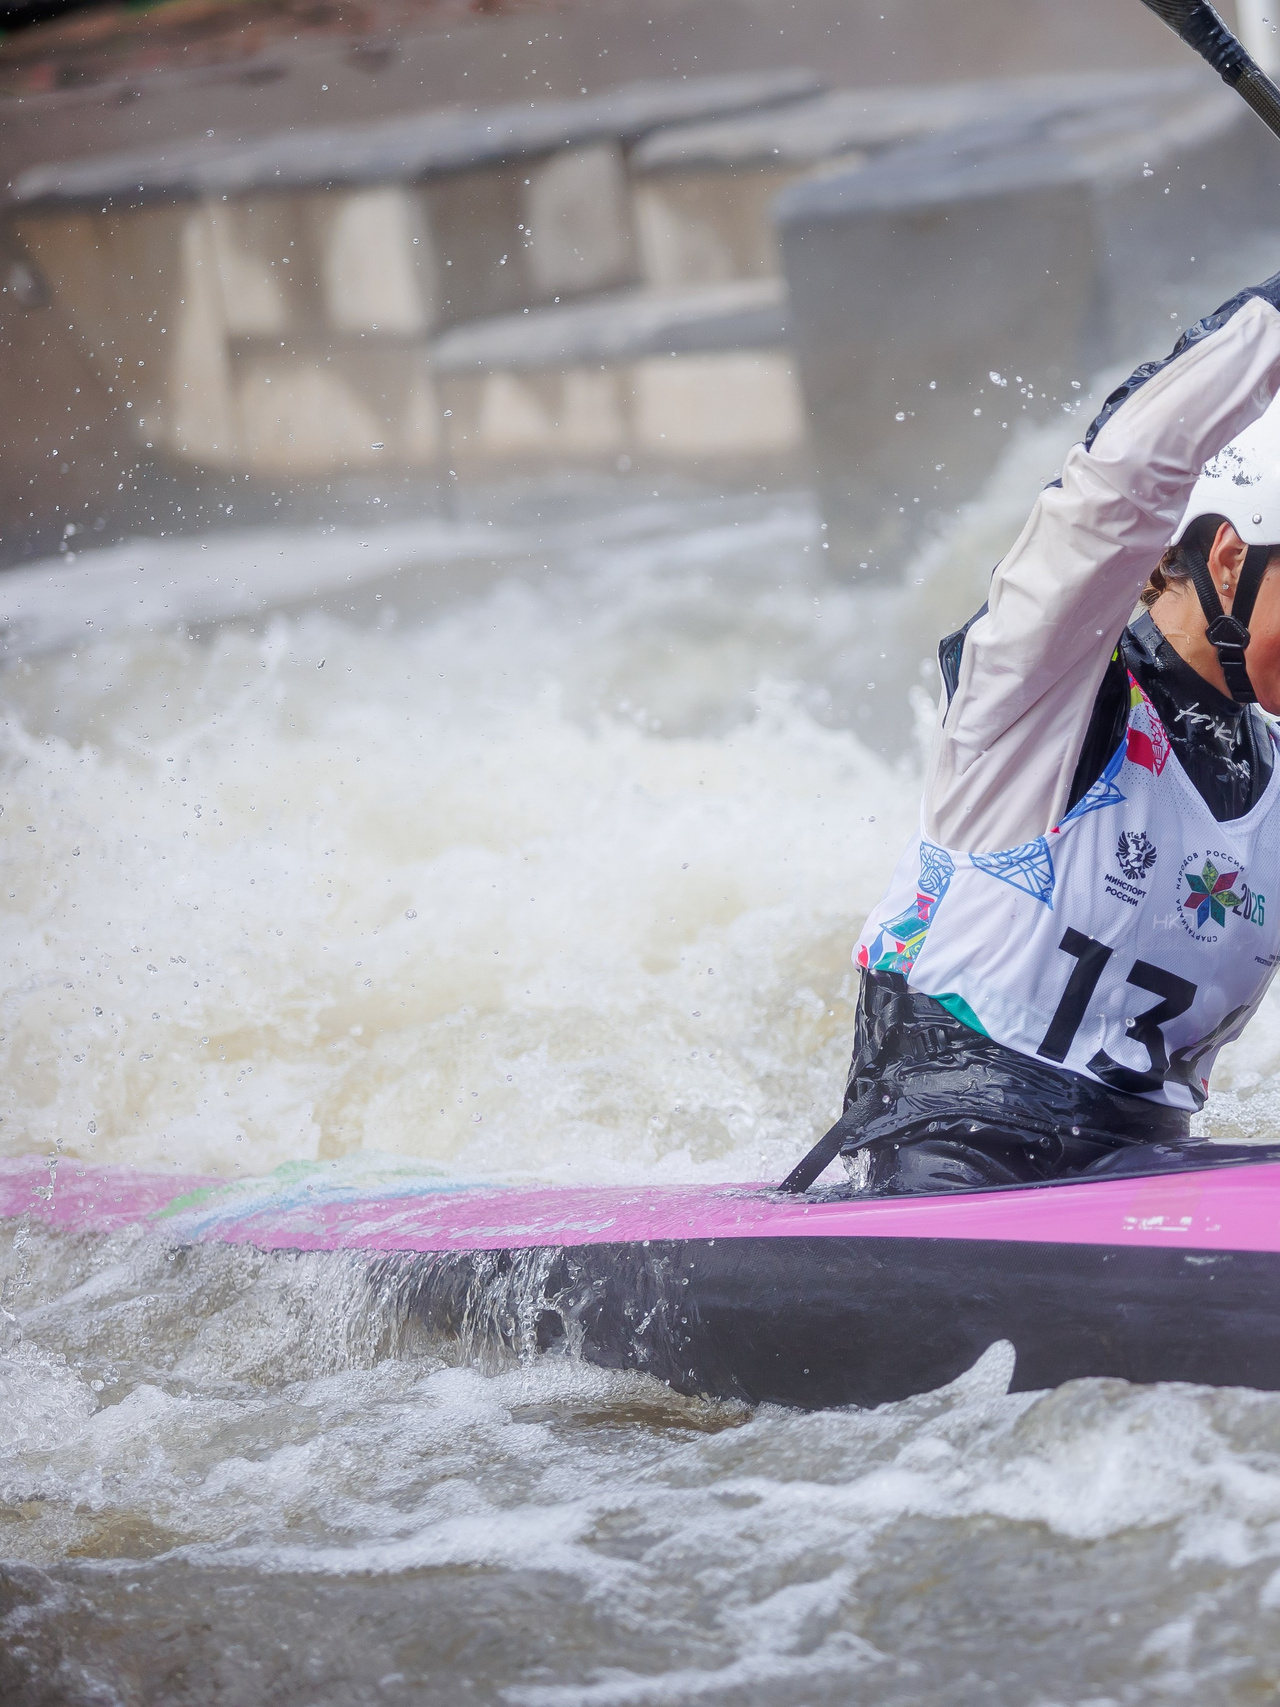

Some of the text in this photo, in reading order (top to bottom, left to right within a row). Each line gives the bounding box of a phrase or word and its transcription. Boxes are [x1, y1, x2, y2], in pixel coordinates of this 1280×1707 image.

[1104, 873, 1147, 899] МИНСПОРТ
[1105, 885, 1139, 907] РОССИИ
[1176, 849, 1245, 943] СПАРТАКИАДА НАРОДОВ РОССИИ
[1232, 883, 1266, 927] 2026
